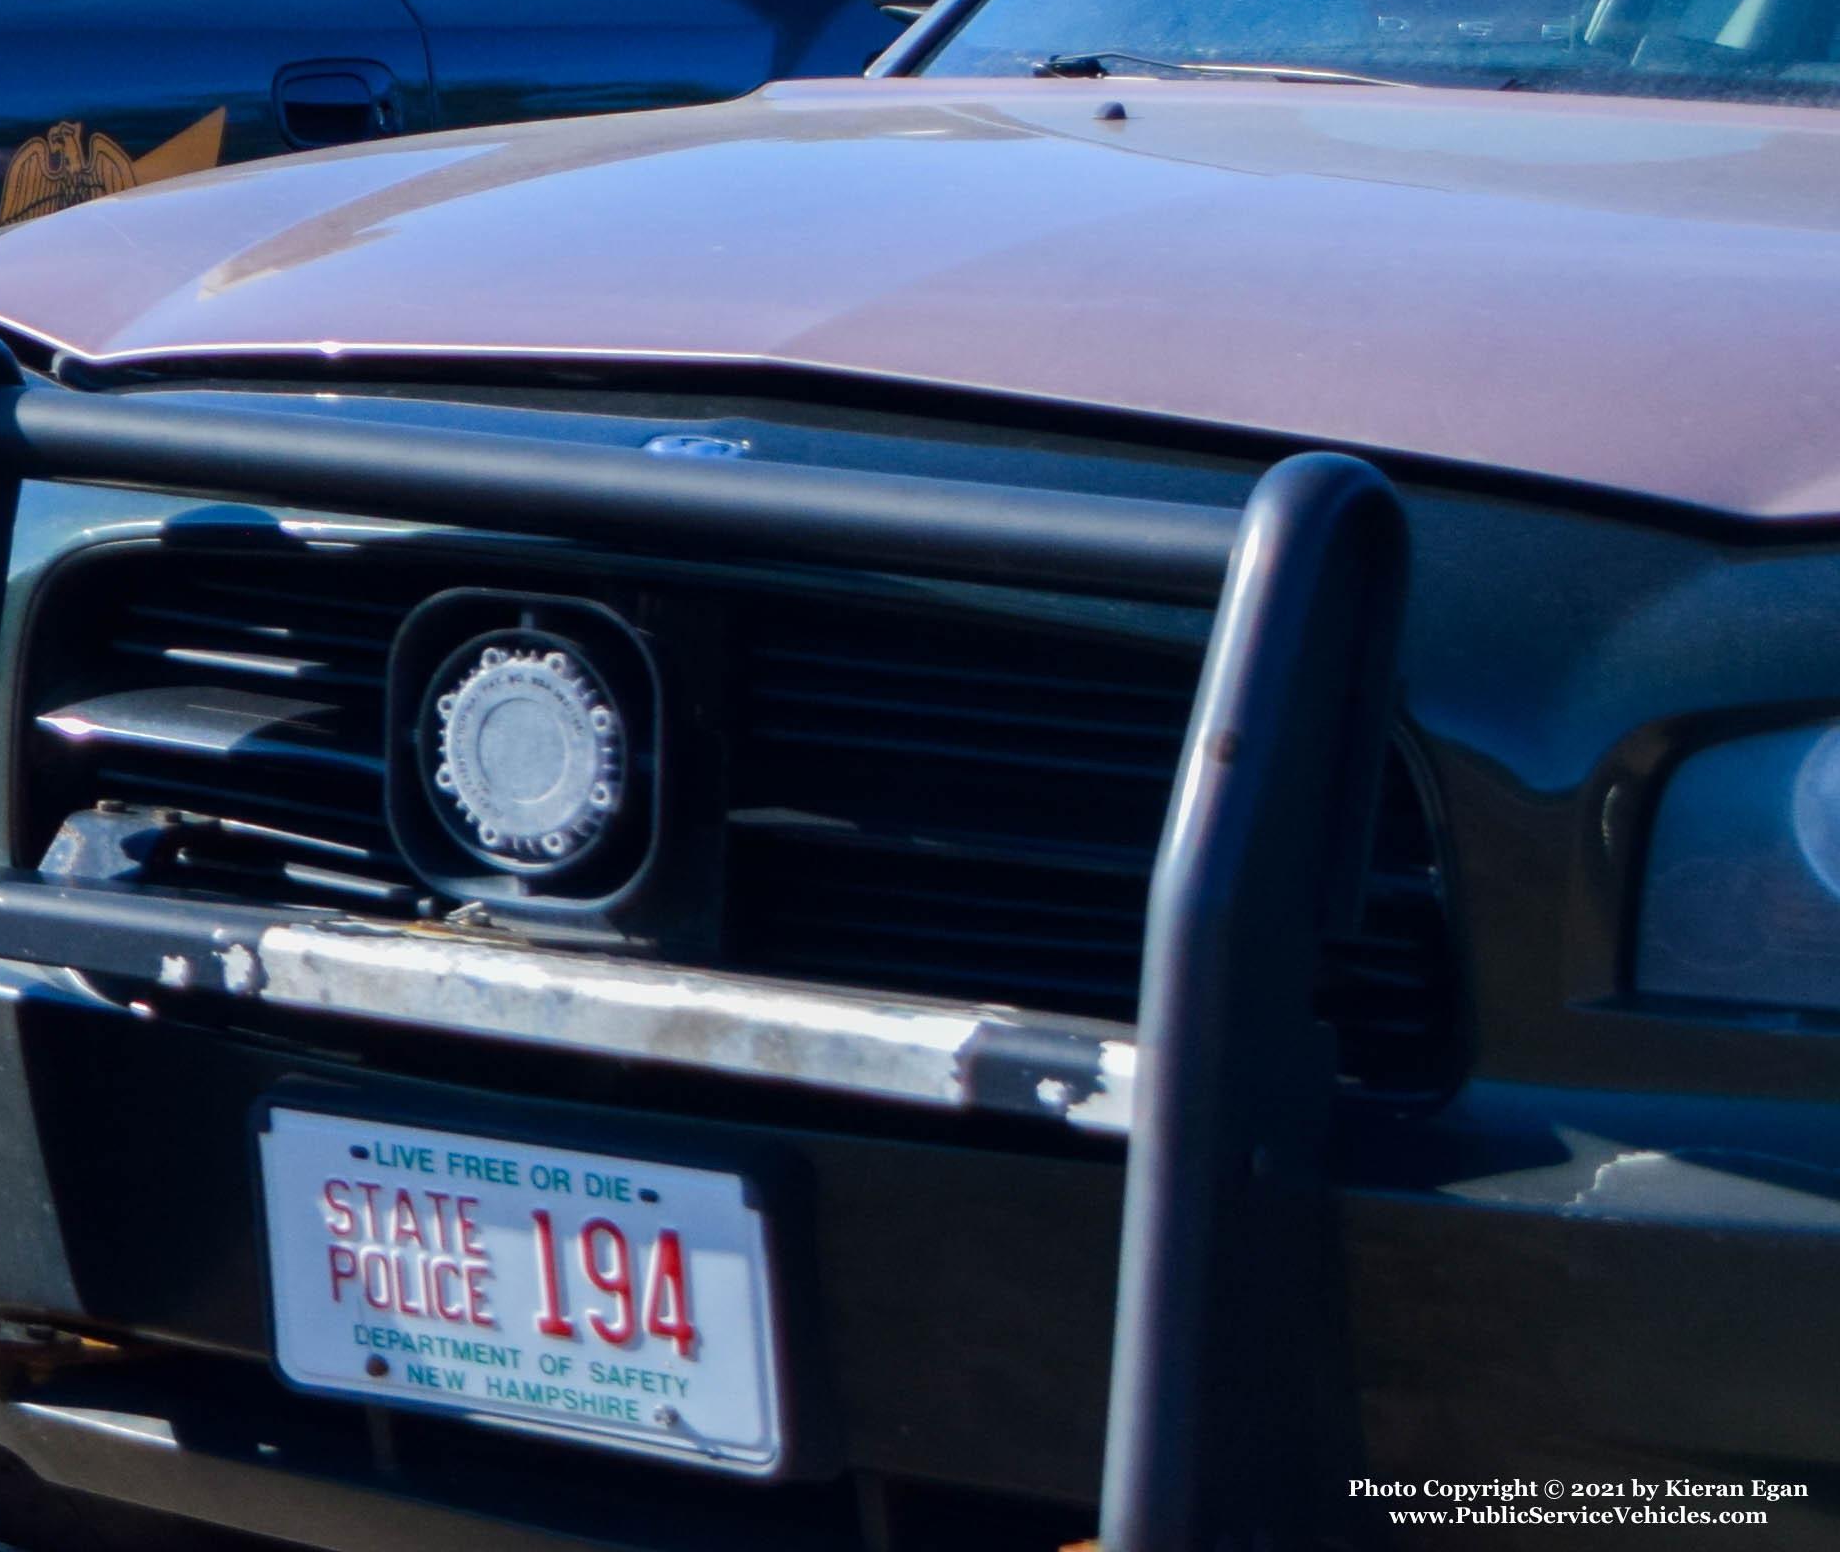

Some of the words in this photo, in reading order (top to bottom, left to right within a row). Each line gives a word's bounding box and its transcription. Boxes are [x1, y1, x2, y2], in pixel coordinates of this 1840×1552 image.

[374, 1140, 436, 1173] LIVE
[447, 1152, 520, 1186] FREE
[532, 1164, 571, 1194] OR
[585, 1174, 633, 1204] DIE
[323, 1179, 484, 1258] STATE
[328, 1245, 495, 1327] POLICE
[532, 1209, 697, 1357] 194
[354, 1323, 523, 1370] DEPARTMENT
[539, 1353, 573, 1378] OF
[590, 1361, 691, 1399] SAFETY
[407, 1363, 467, 1391] NEW
[486, 1374, 640, 1422] HAMPSHIRE
